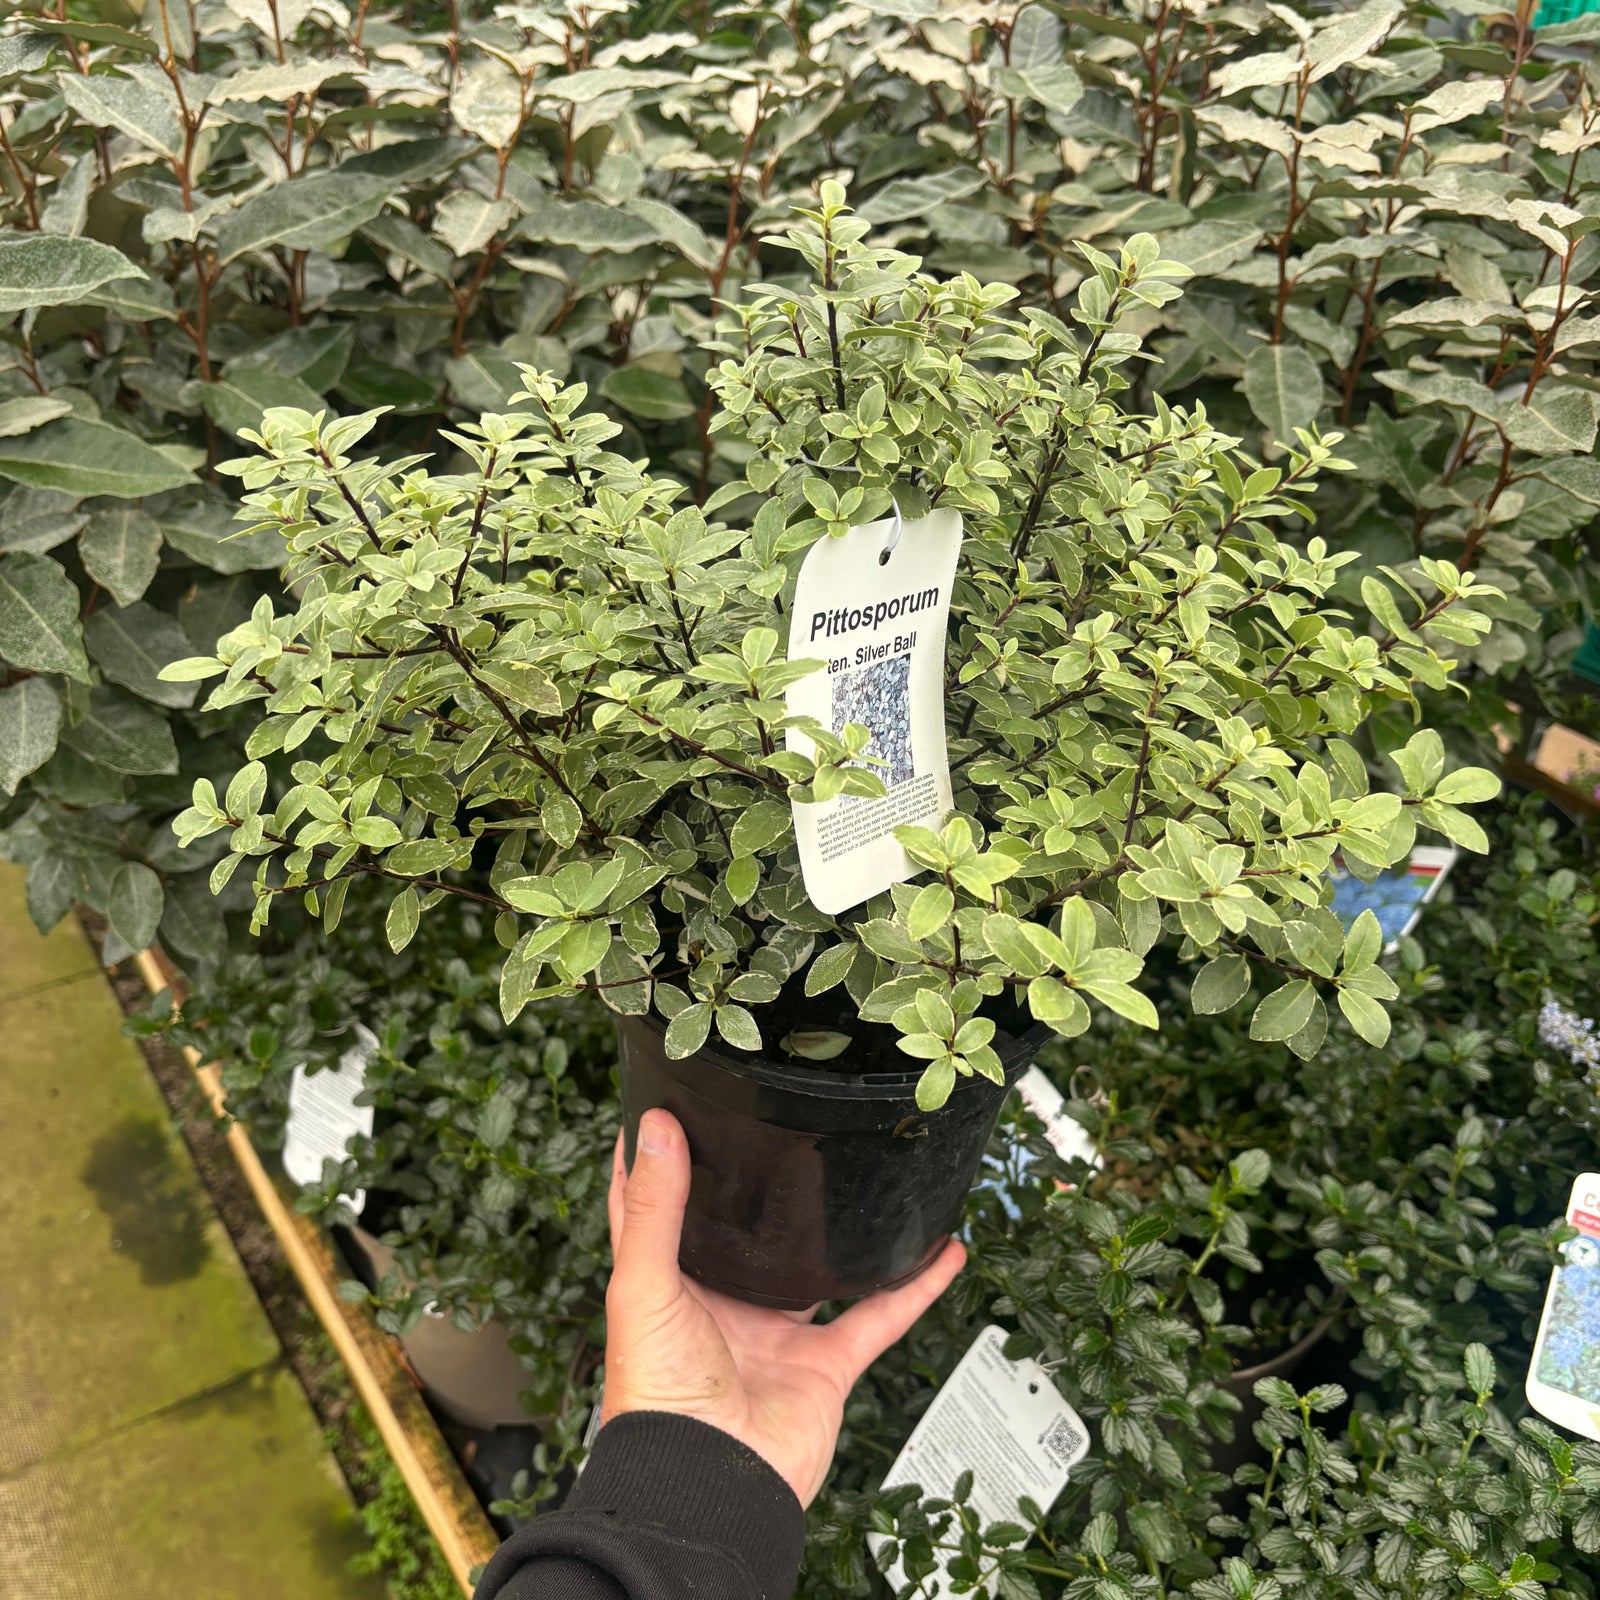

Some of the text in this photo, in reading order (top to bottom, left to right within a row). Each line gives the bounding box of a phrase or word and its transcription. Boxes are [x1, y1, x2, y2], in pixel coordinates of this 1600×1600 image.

[810, 587, 939, 642] Pittosporum
[855, 643, 891, 665] Silver
[893, 631, 917, 653] Ball
